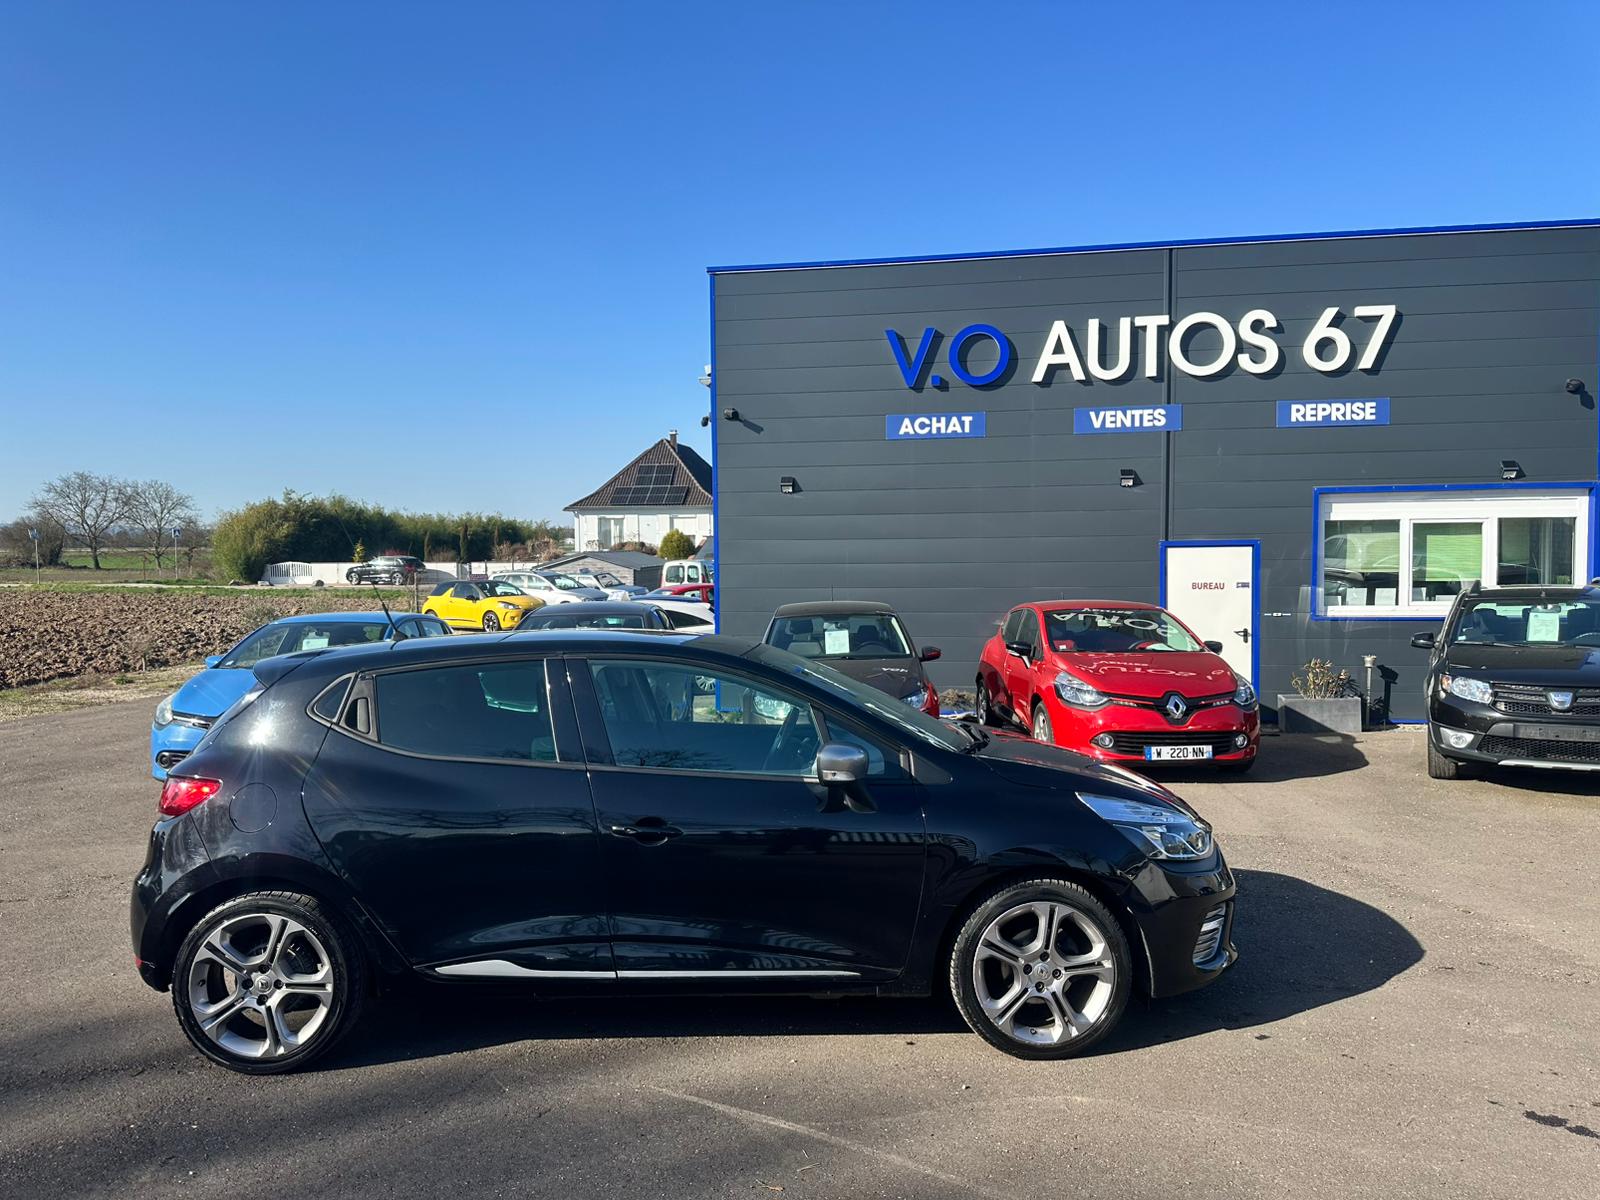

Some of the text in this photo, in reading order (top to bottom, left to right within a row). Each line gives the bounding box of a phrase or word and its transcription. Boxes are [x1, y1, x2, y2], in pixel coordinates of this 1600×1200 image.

[885, 304, 1396, 388] V.O AUTOS 67
[1089, 408, 1167, 430] VENTES
[1290, 401, 1377, 422] REPRISE
[898, 415, 973, 436] ACHAT
[1191, 581, 1225, 590] BUREAU
